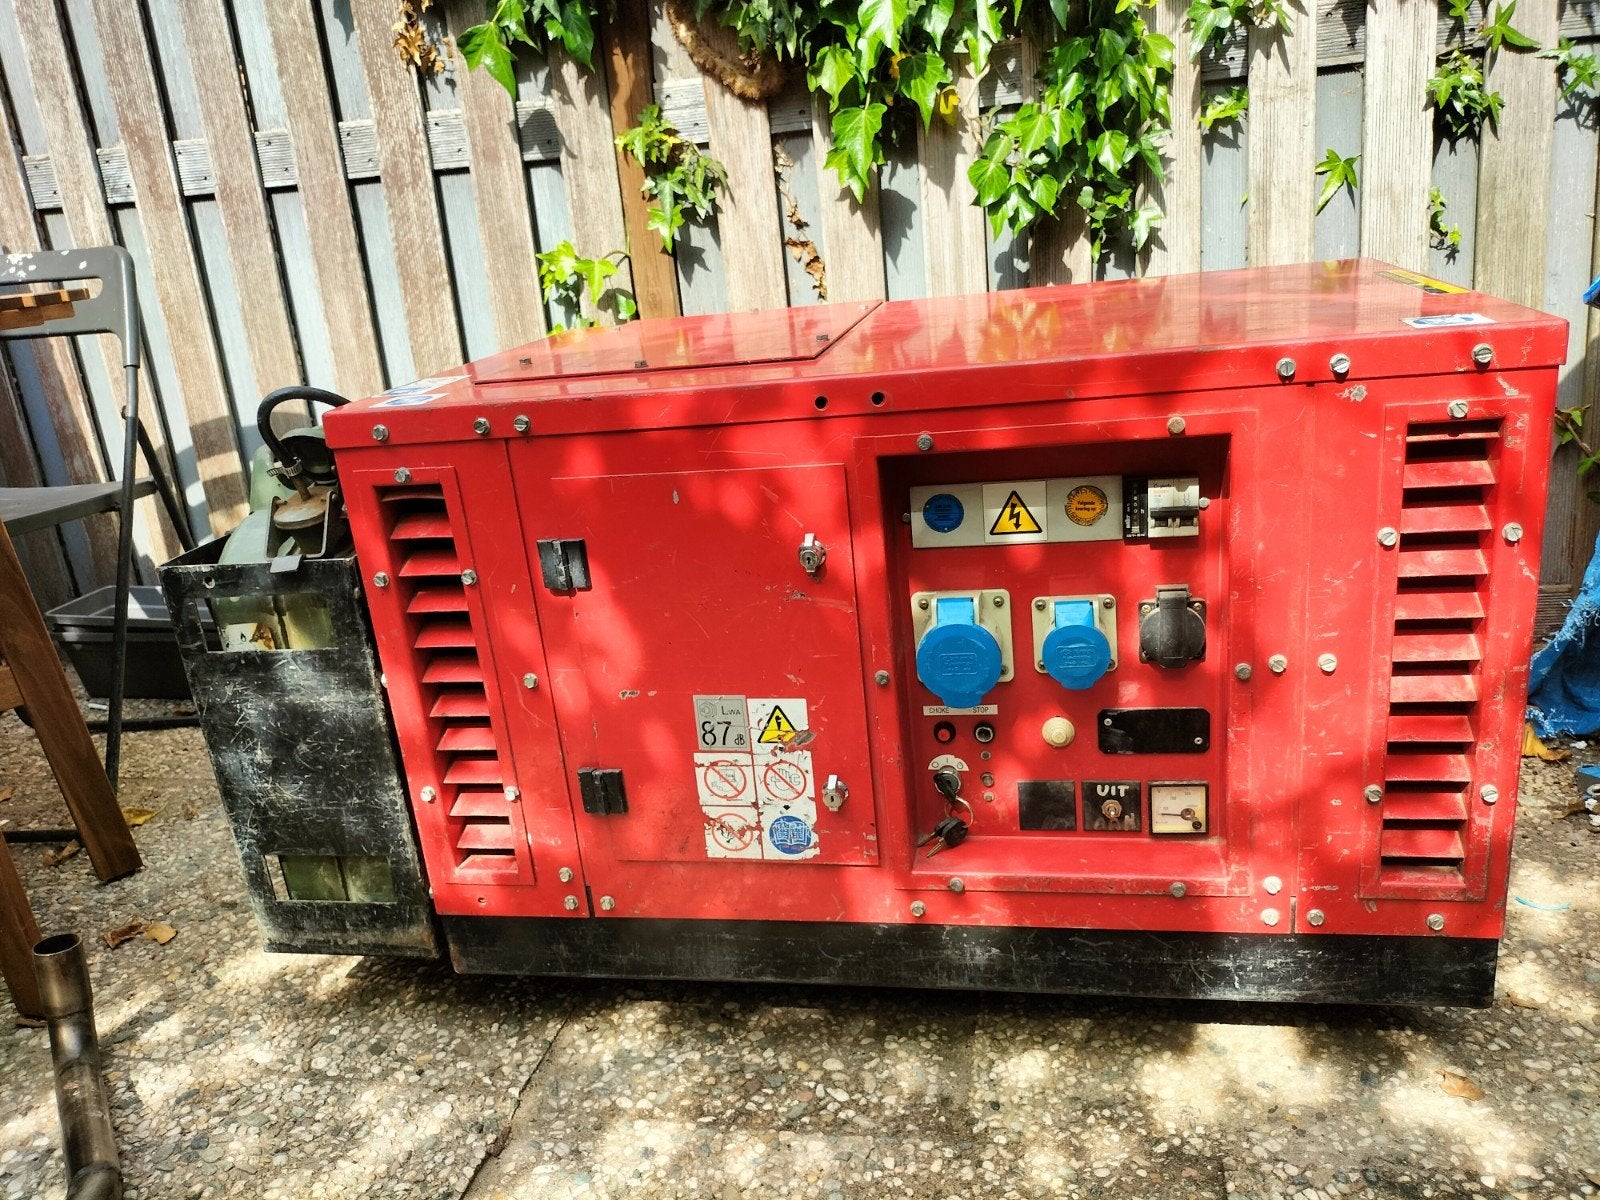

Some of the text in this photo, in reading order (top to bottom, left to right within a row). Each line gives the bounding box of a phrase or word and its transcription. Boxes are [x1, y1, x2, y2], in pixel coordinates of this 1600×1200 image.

[972, 706, 990, 714] STOP
[702, 721, 745, 745] 87 dB
[1096, 784, 1130, 798] UIT
